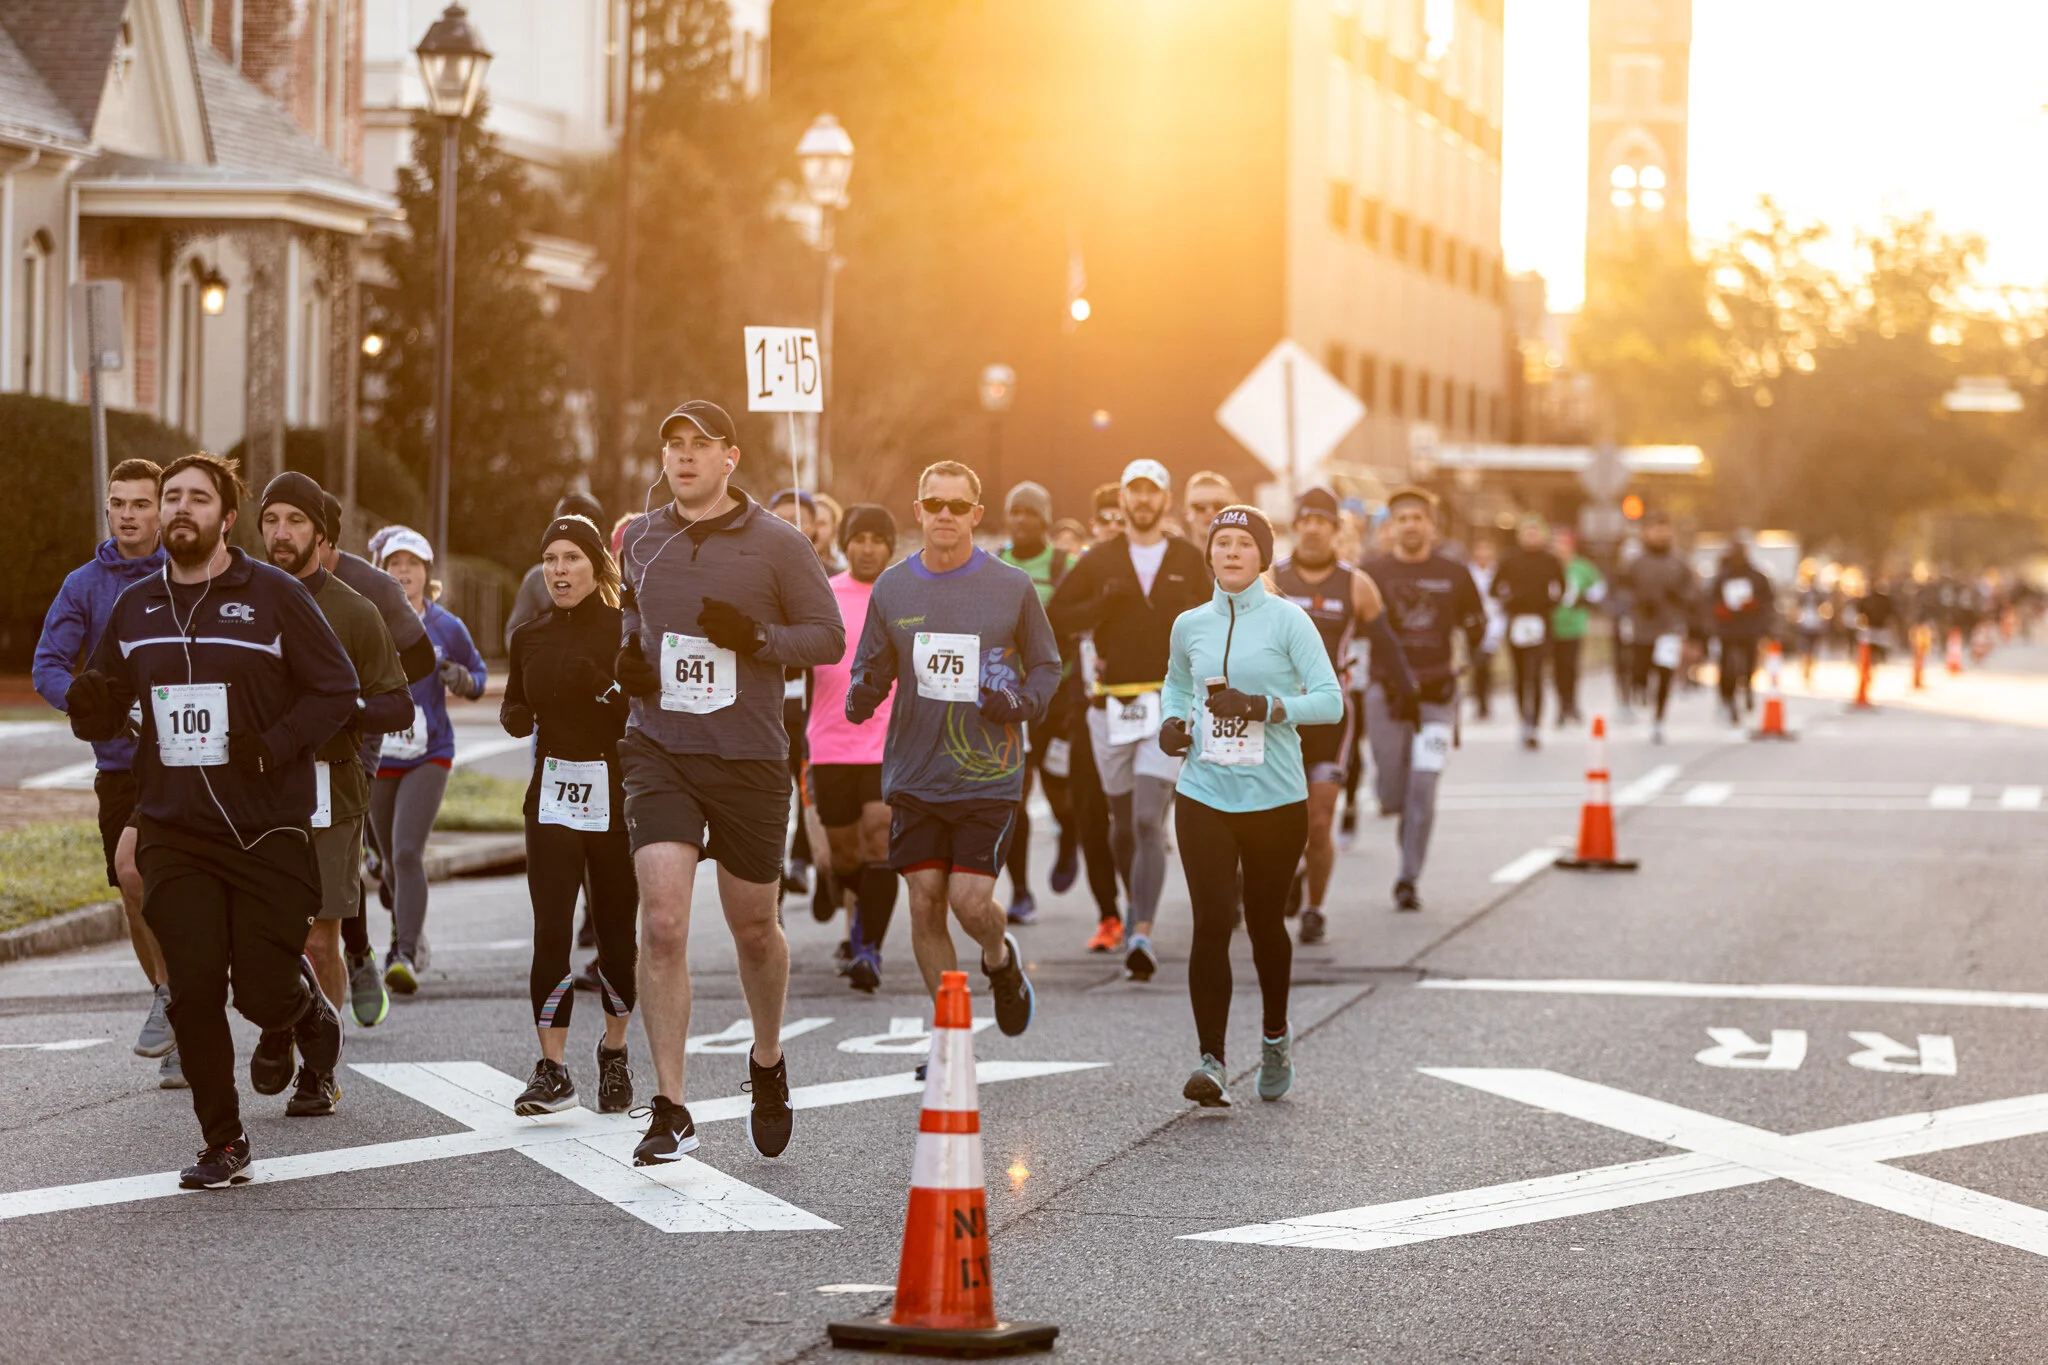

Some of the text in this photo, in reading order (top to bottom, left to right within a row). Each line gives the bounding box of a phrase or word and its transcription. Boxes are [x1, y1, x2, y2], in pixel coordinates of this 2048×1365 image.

[755, 336, 817, 398] 1:45
[676, 658, 714, 684] 641
[927, 654, 964, 675] 475
[169, 708, 211, 735] 100
[1212, 715, 1248, 738] 352
[555, 781, 592, 804] 737
